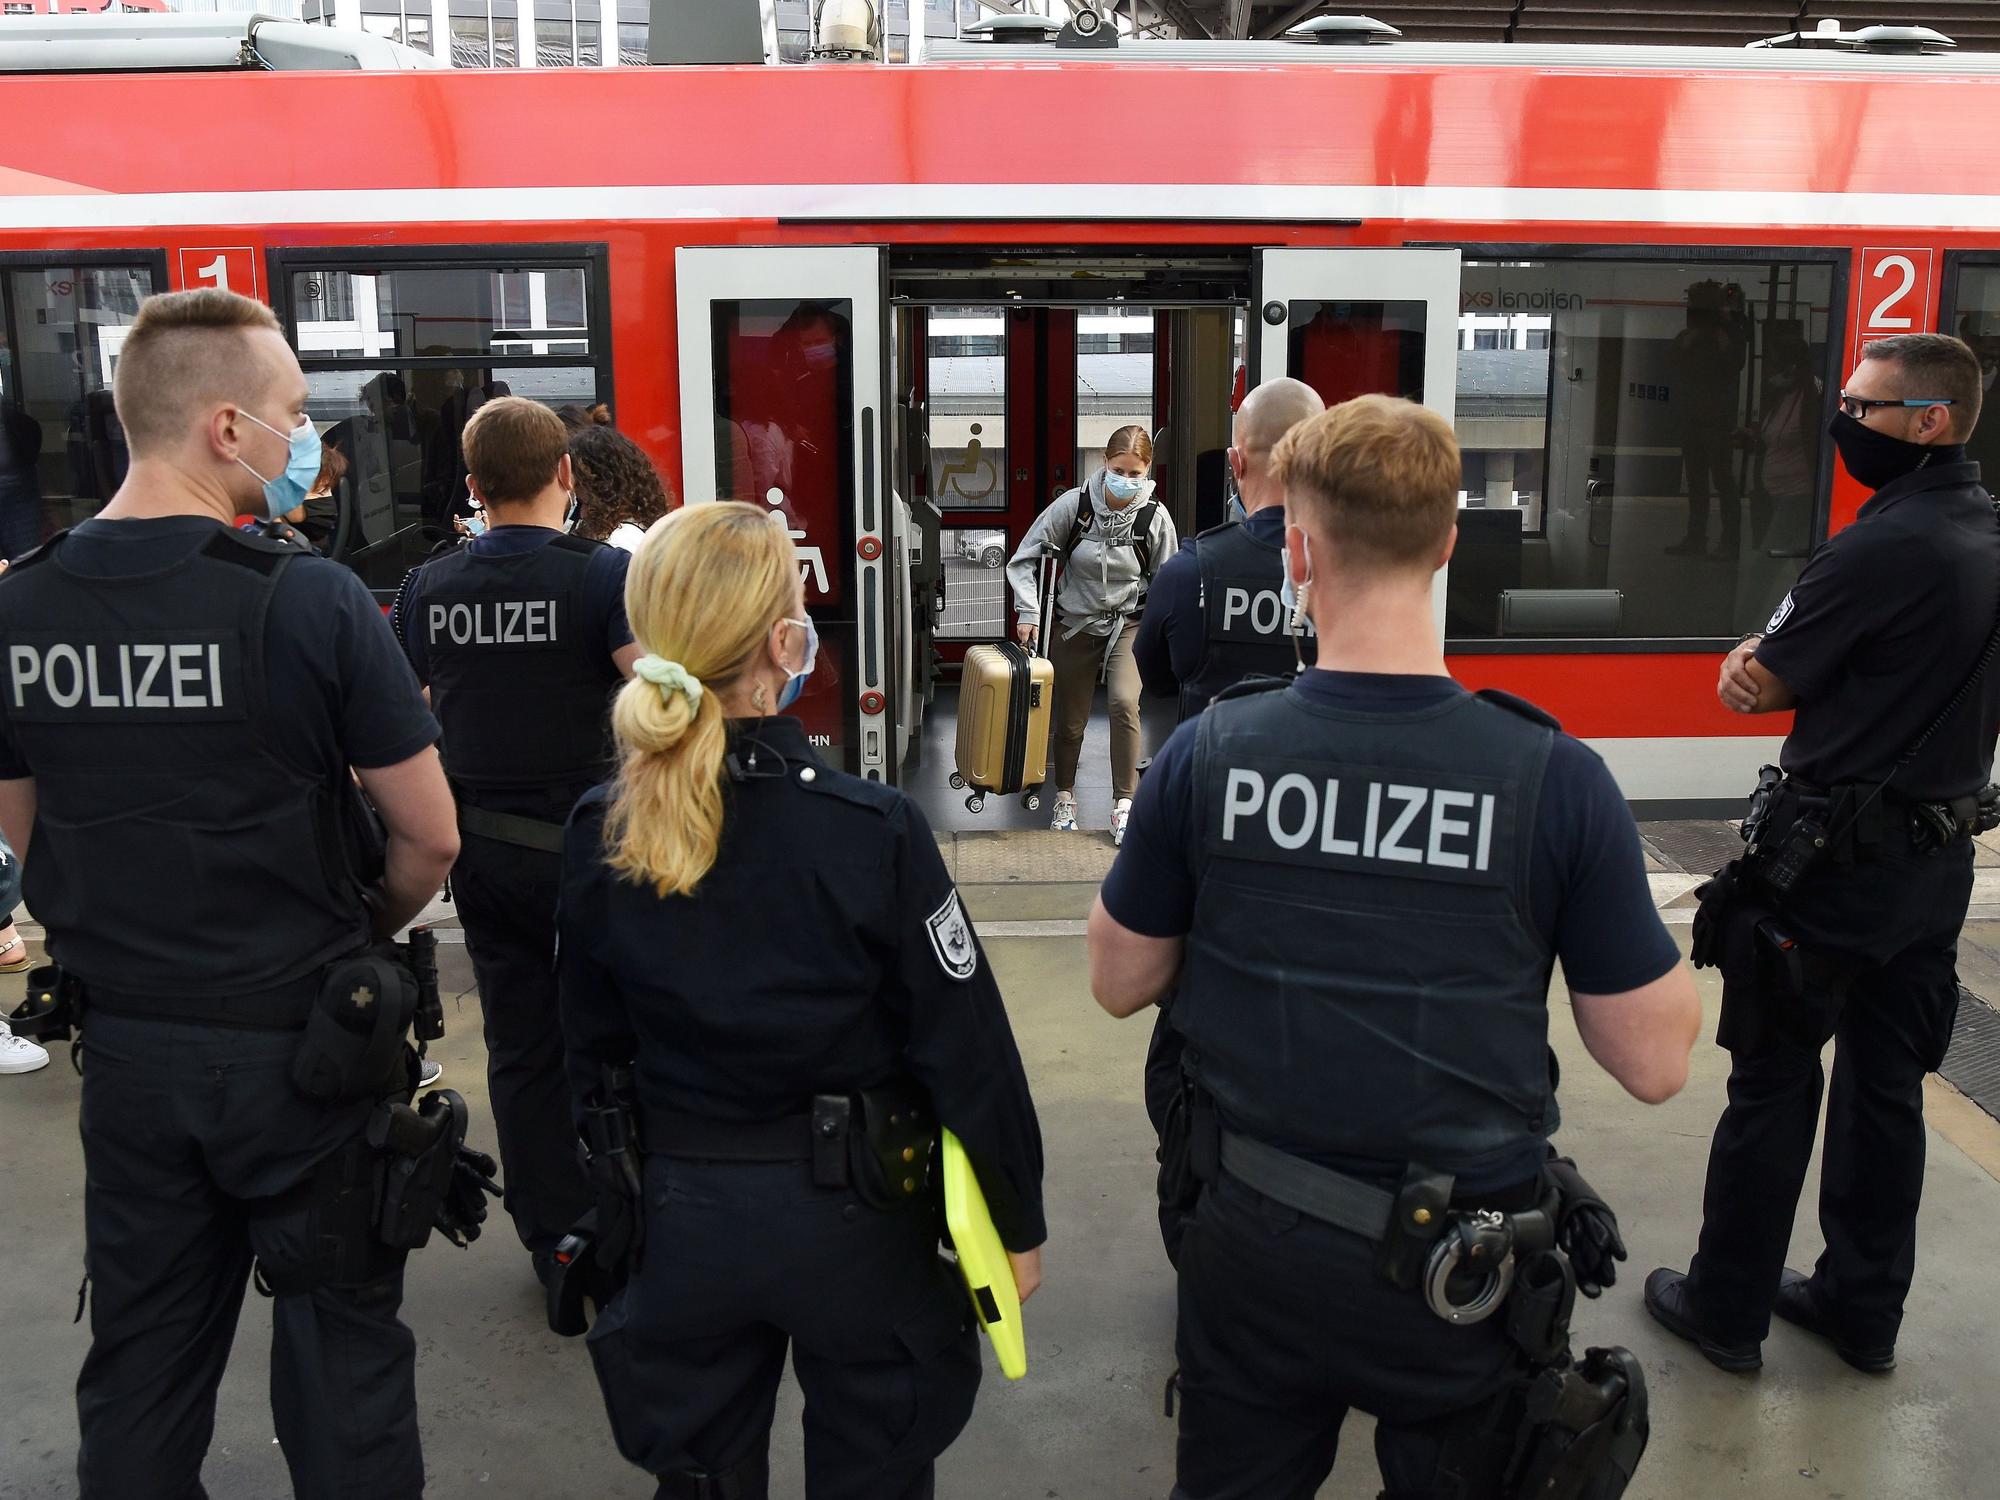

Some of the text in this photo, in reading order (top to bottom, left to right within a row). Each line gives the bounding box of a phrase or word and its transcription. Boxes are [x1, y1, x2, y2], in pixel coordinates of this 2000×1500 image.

[198, 255, 228, 292] 1
[1868, 255, 1915, 328] 2
[428, 600, 557, 645] POLIZEI
[1223, 587, 1316, 637] POL
[9, 643, 224, 708] POLIZEI
[1222, 768, 1496, 871] POLIZEI
